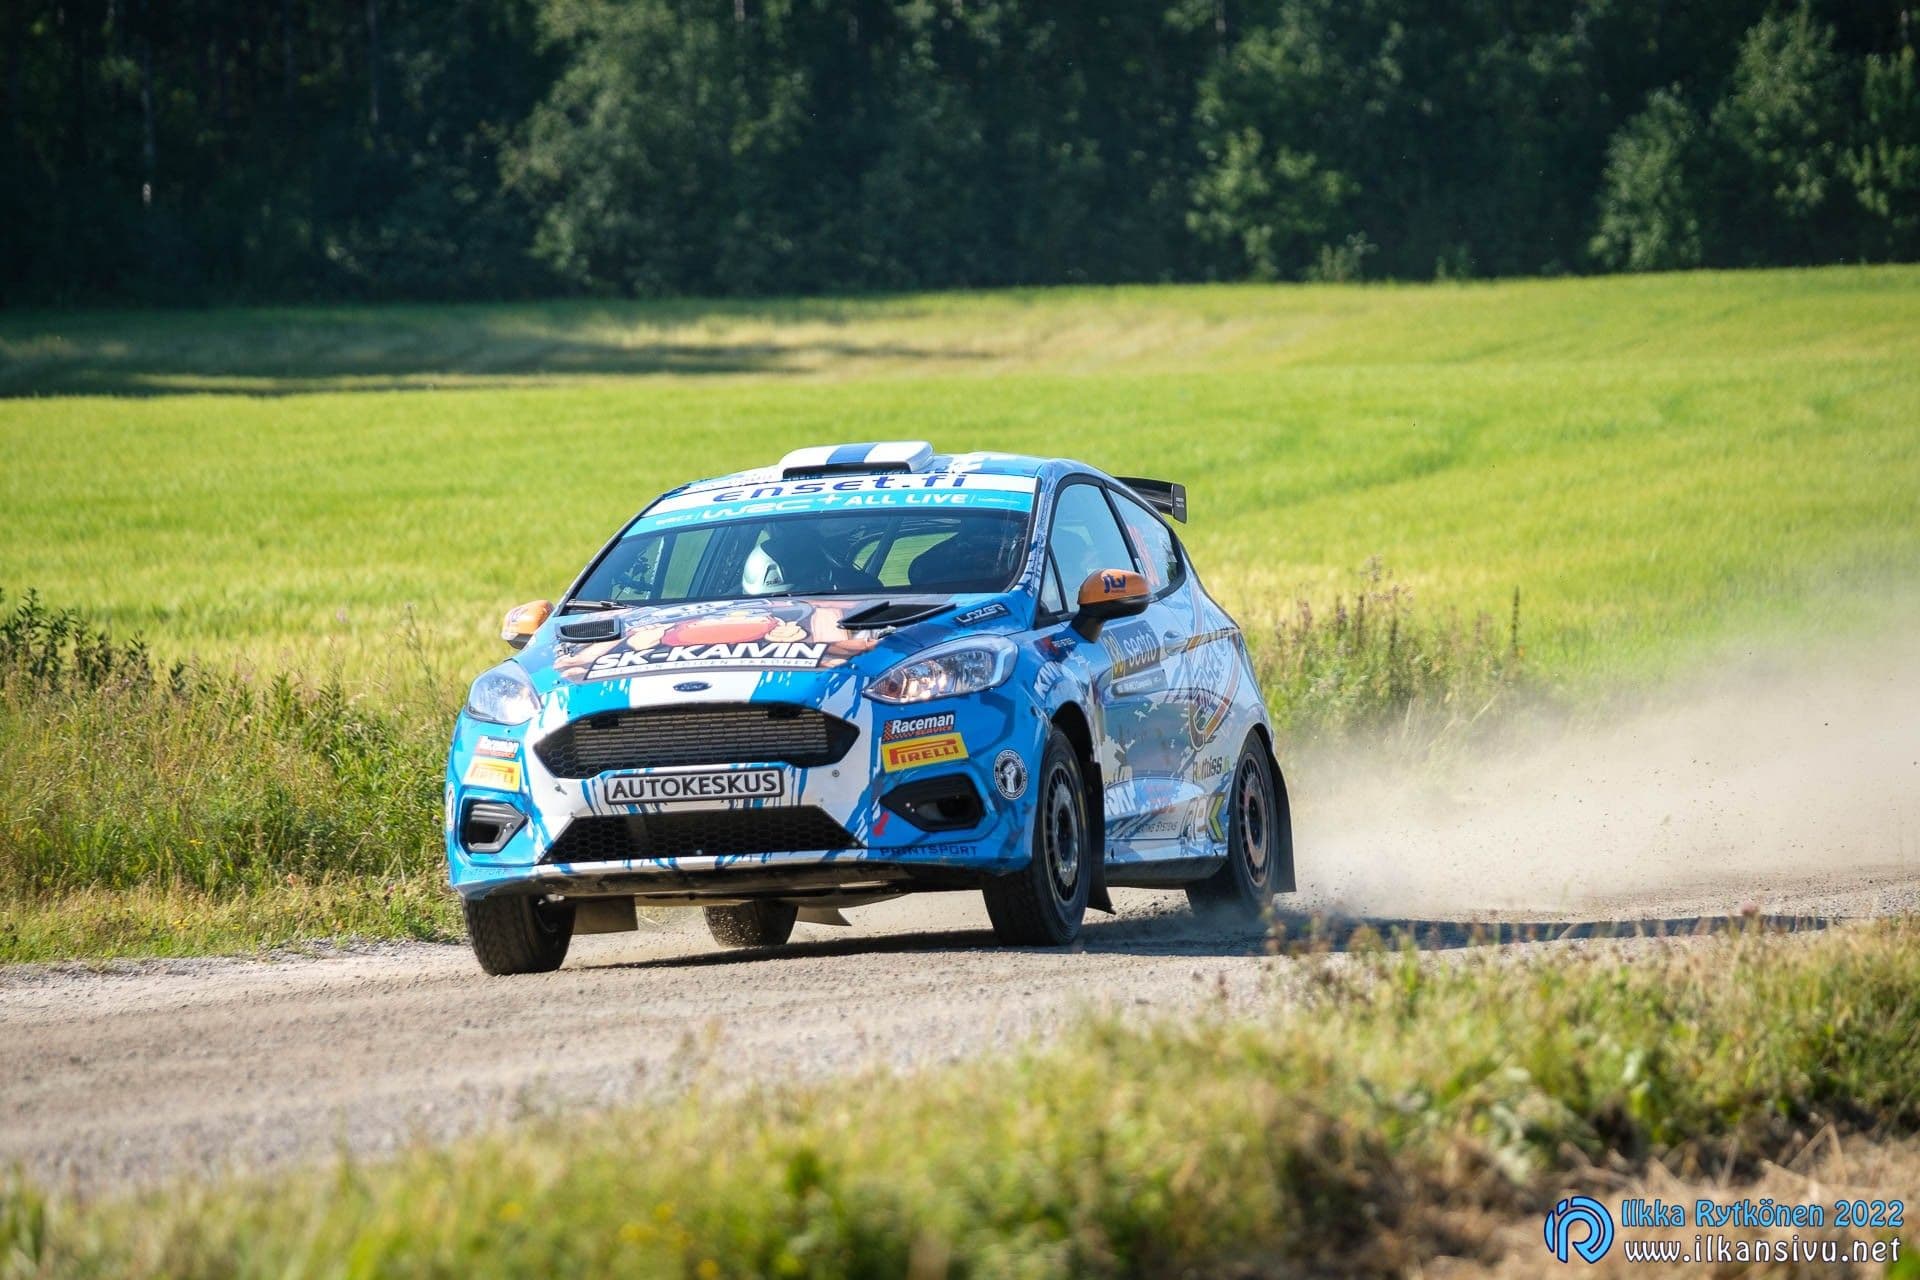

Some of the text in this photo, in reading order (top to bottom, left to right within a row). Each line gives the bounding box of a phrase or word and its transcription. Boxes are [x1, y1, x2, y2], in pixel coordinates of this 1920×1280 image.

[713, 473, 968, 503] enset.fi
[845, 493, 896, 505] ALL
[905, 493, 968, 504] LIVE
[891, 713, 955, 735] Raceman
[888, 738, 960, 766] PIRELLI
[611, 772, 778, 800] AUTOKESKUS
